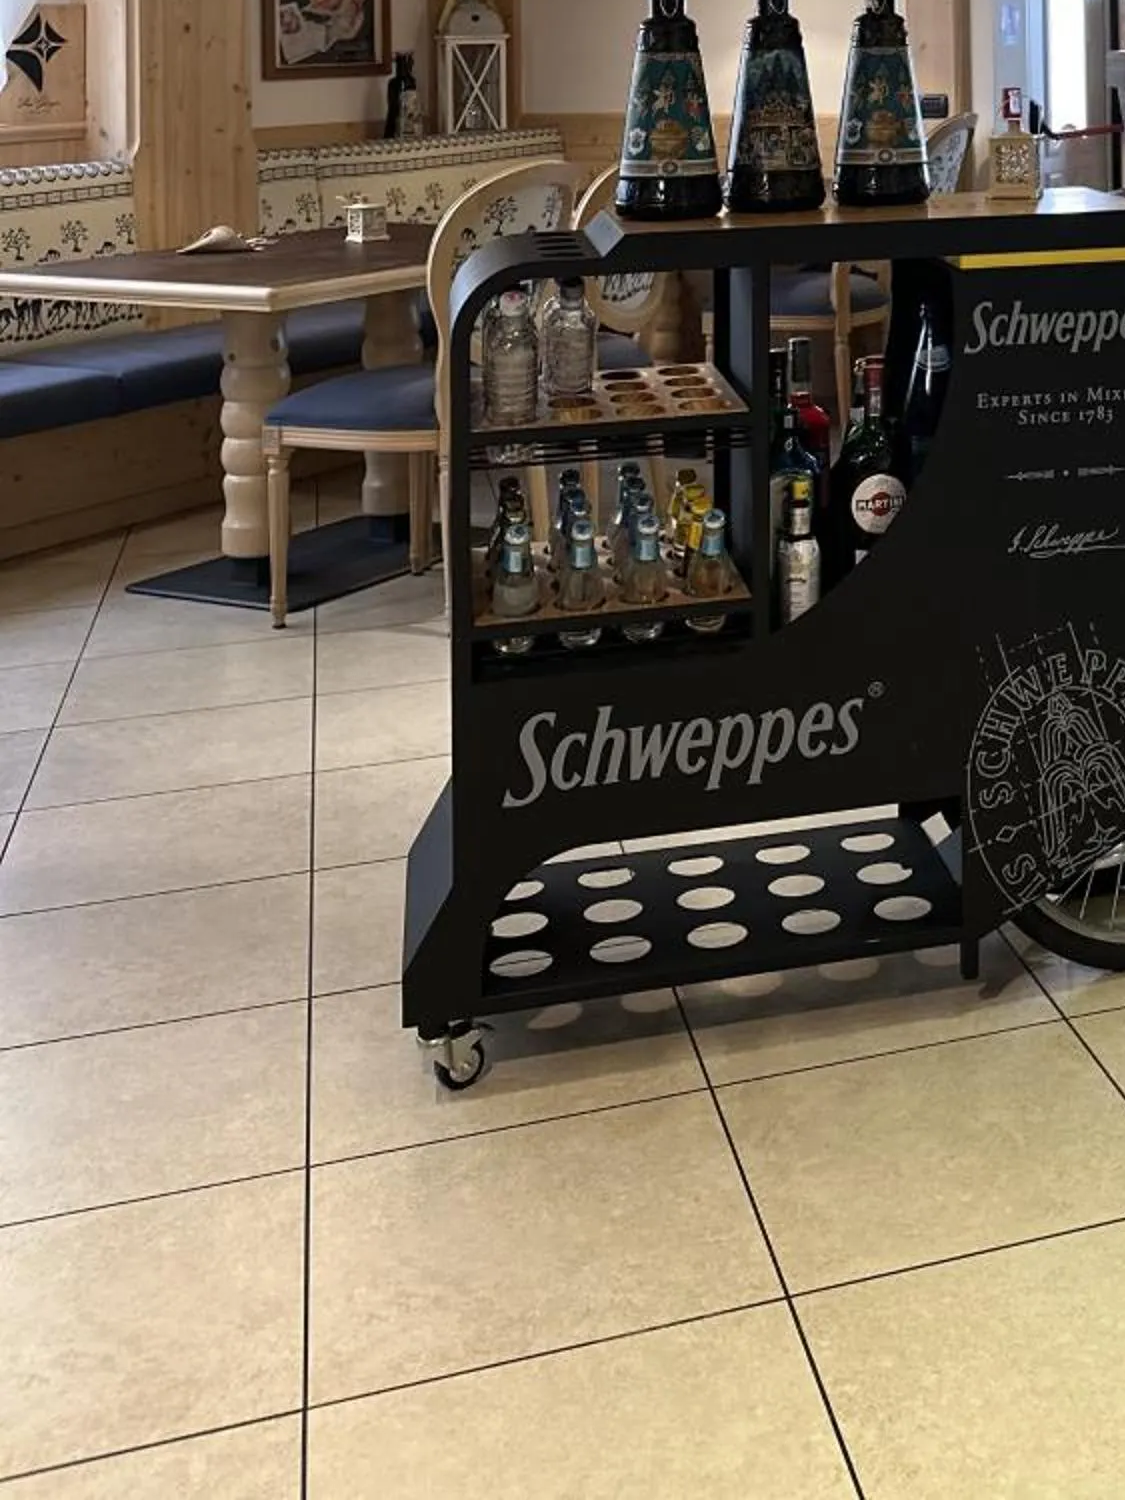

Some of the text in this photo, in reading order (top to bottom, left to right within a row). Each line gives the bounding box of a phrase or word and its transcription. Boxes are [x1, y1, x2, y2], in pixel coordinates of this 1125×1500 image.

[1017, 404, 1114, 426] SINCE 1783
[501, 697, 865, 808] Schweppes
